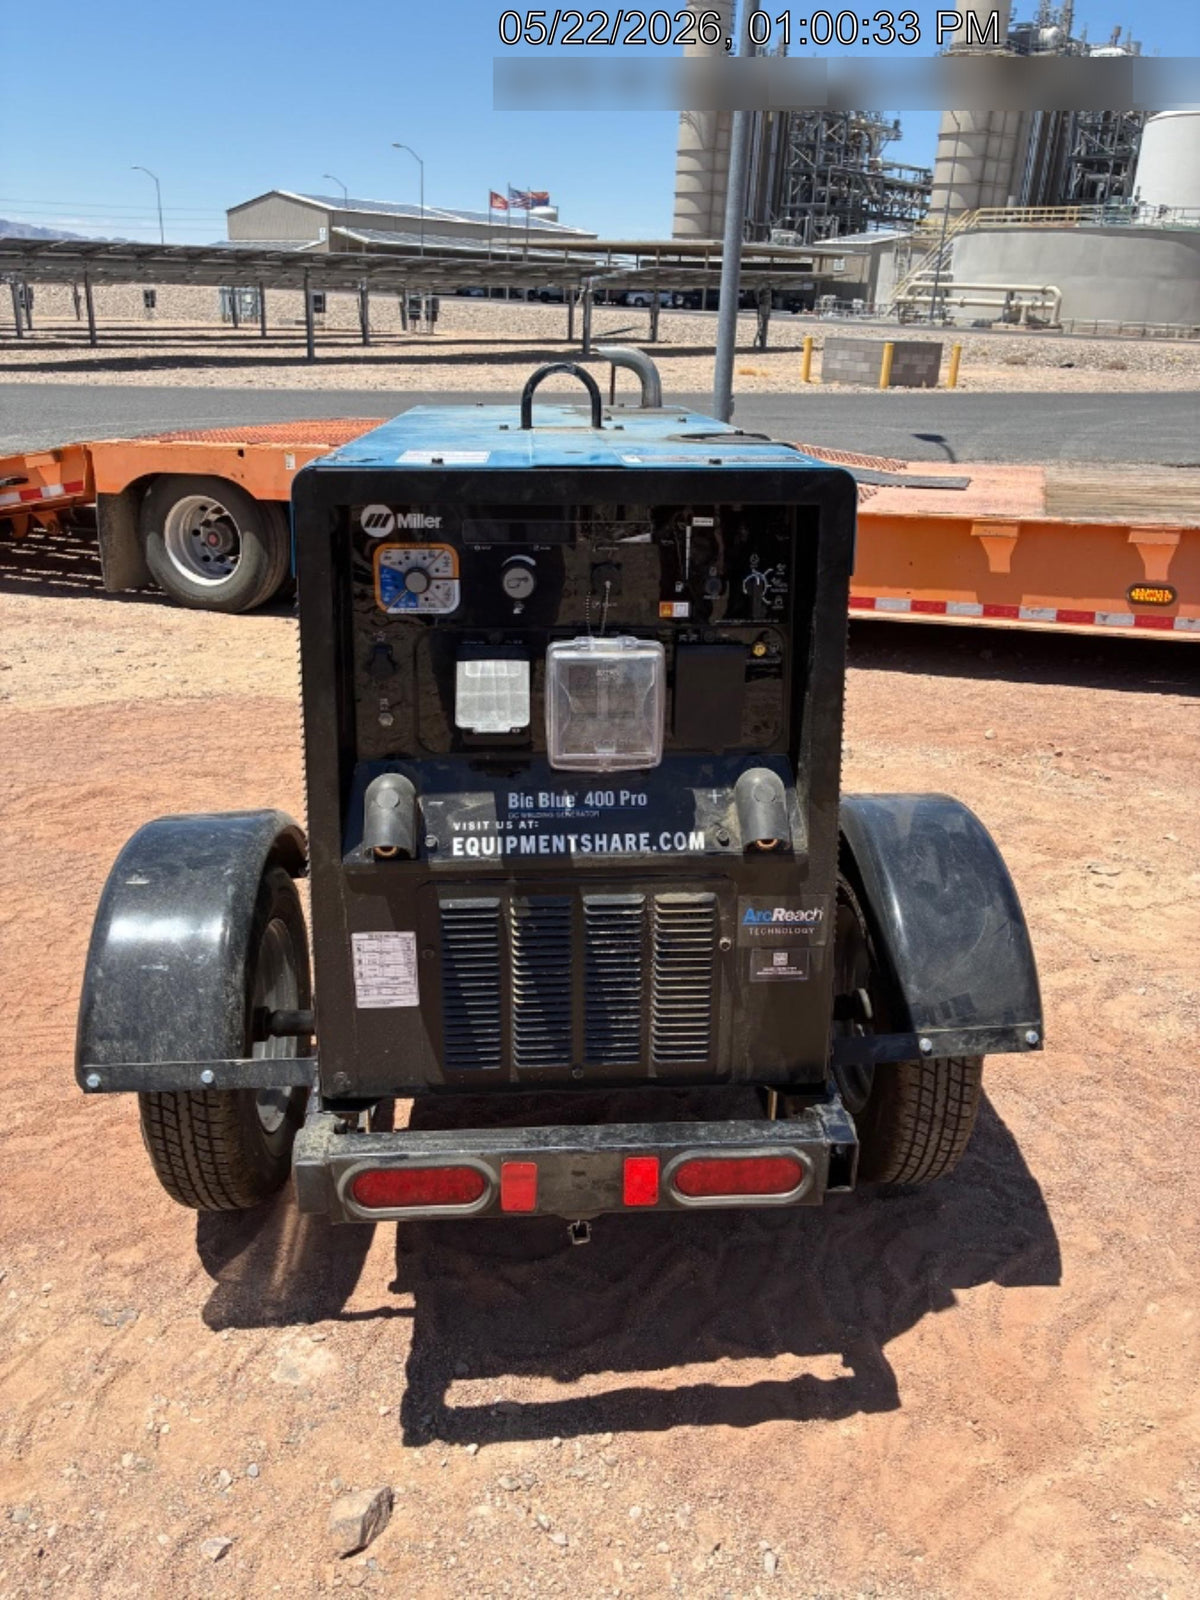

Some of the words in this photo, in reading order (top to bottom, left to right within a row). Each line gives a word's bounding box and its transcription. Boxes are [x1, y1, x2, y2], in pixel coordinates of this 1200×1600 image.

[397, 513, 442, 529] Miller
[538, 791, 575, 807] Blue
[584, 790, 615, 806] 400
[619, 790, 648, 806] Pro
[452, 821, 490, 830] VISIT
[496, 821, 513, 829] US
[519, 820, 540, 829] AT:
[452, 831, 705, 856] EQUIPMENTSHARE.COM
[742, 907, 823, 922] ArcReach
[748, 927, 816, 936] TECHNOLOGY
